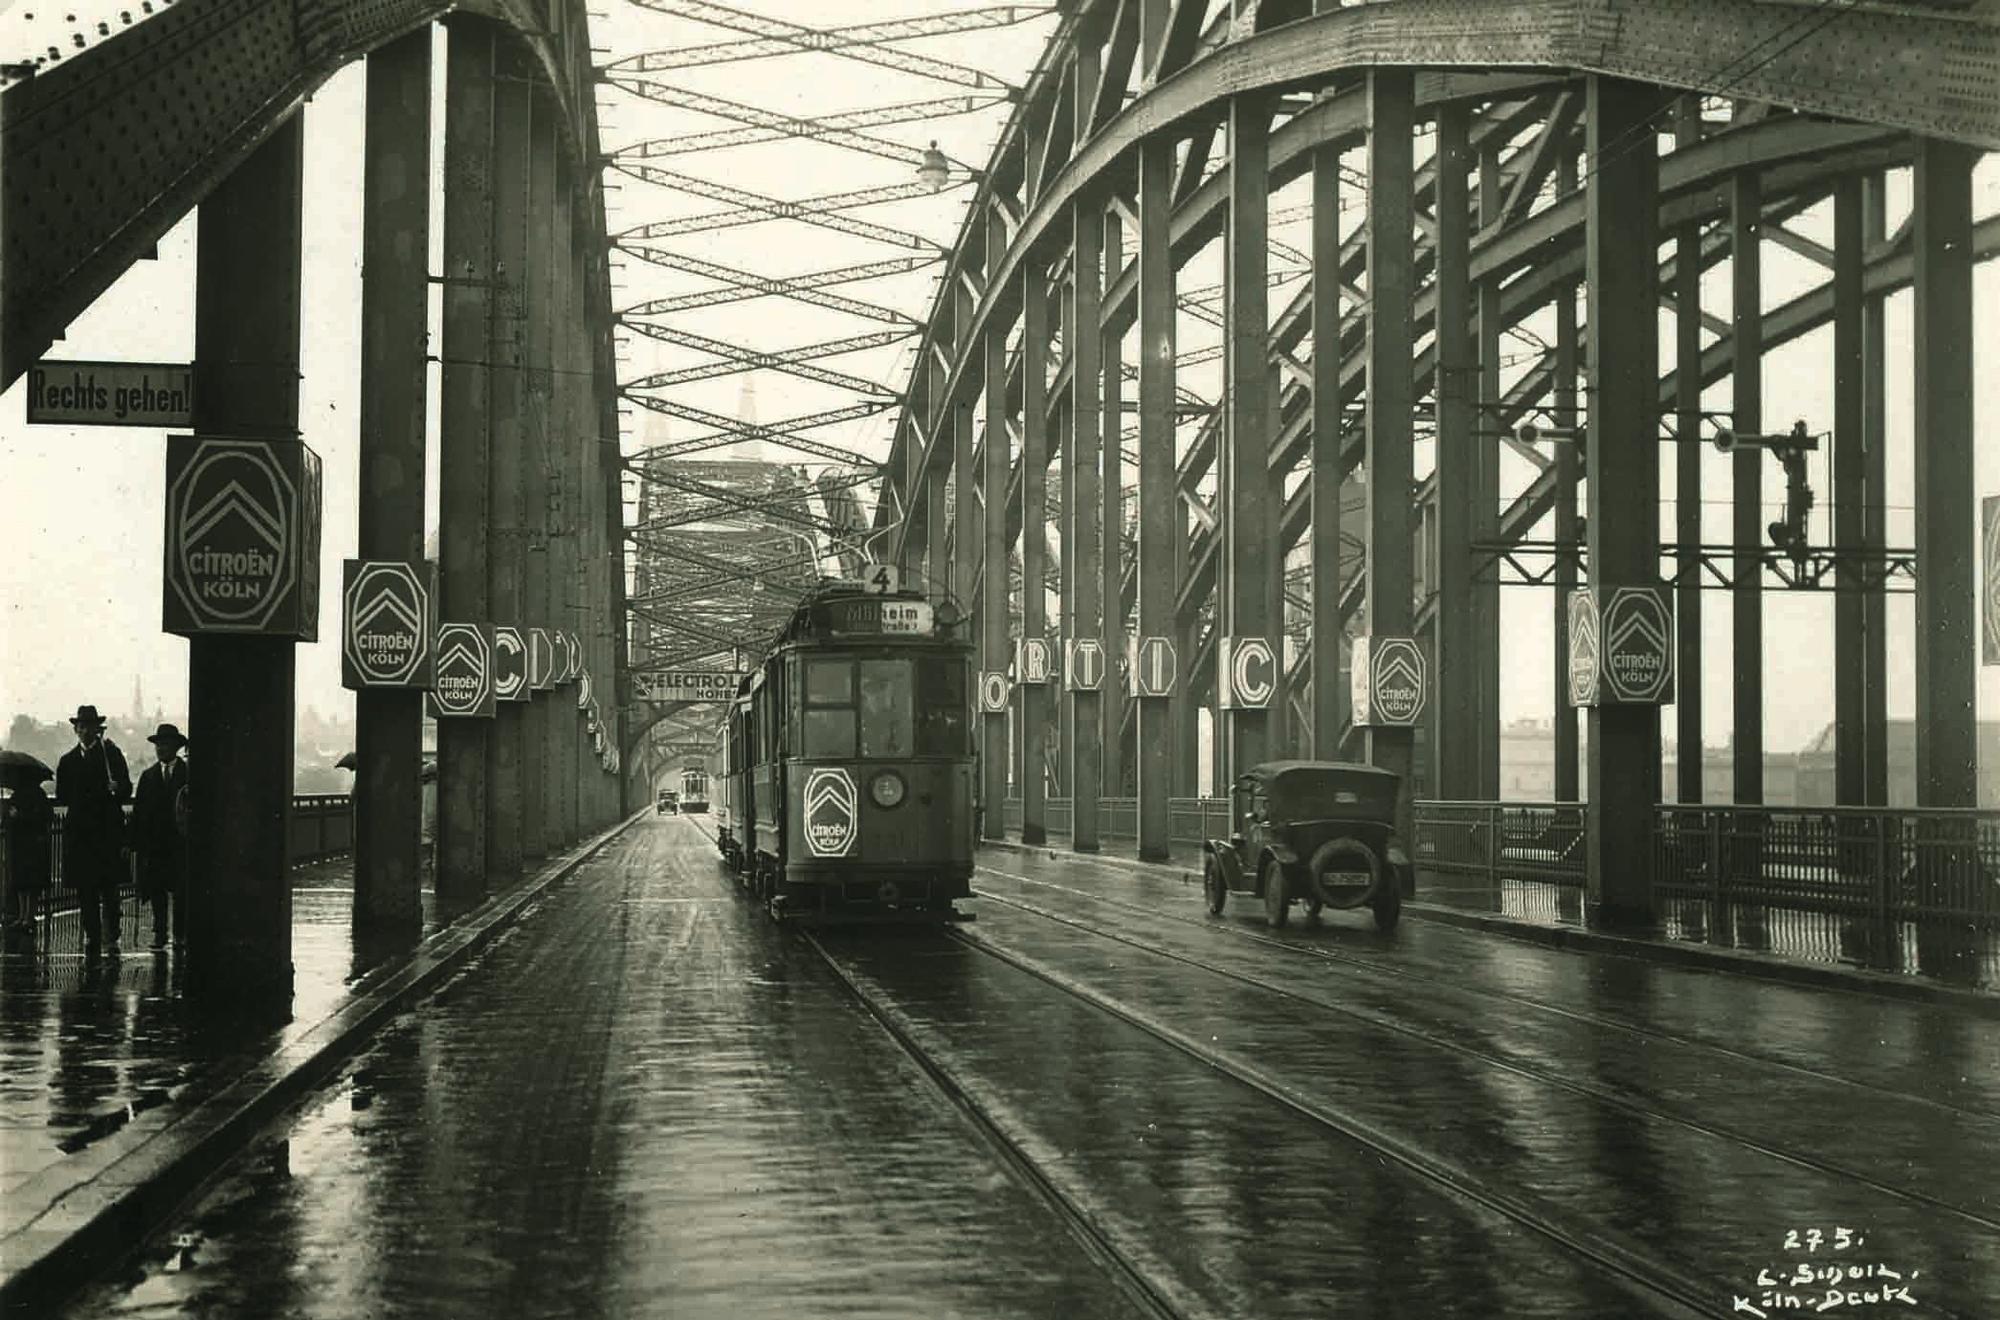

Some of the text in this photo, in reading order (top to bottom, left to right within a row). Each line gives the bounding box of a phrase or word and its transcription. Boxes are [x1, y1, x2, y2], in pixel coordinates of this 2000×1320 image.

[33, 369, 190, 418] Rechts gehen!
[204, 577, 260, 598] KÖLN
[872, 567, 891, 592] 4
[368, 651, 405, 665] KÖLN
[1028, 642, 1044, 679] R
[1080, 643, 1097, 685] T
[656, 674, 738, 688] ELECTROL
[1235, 643, 1270, 701] C
[1621, 668, 1654, 682] KÖLN
[445, 689, 473, 699] KÖLN
